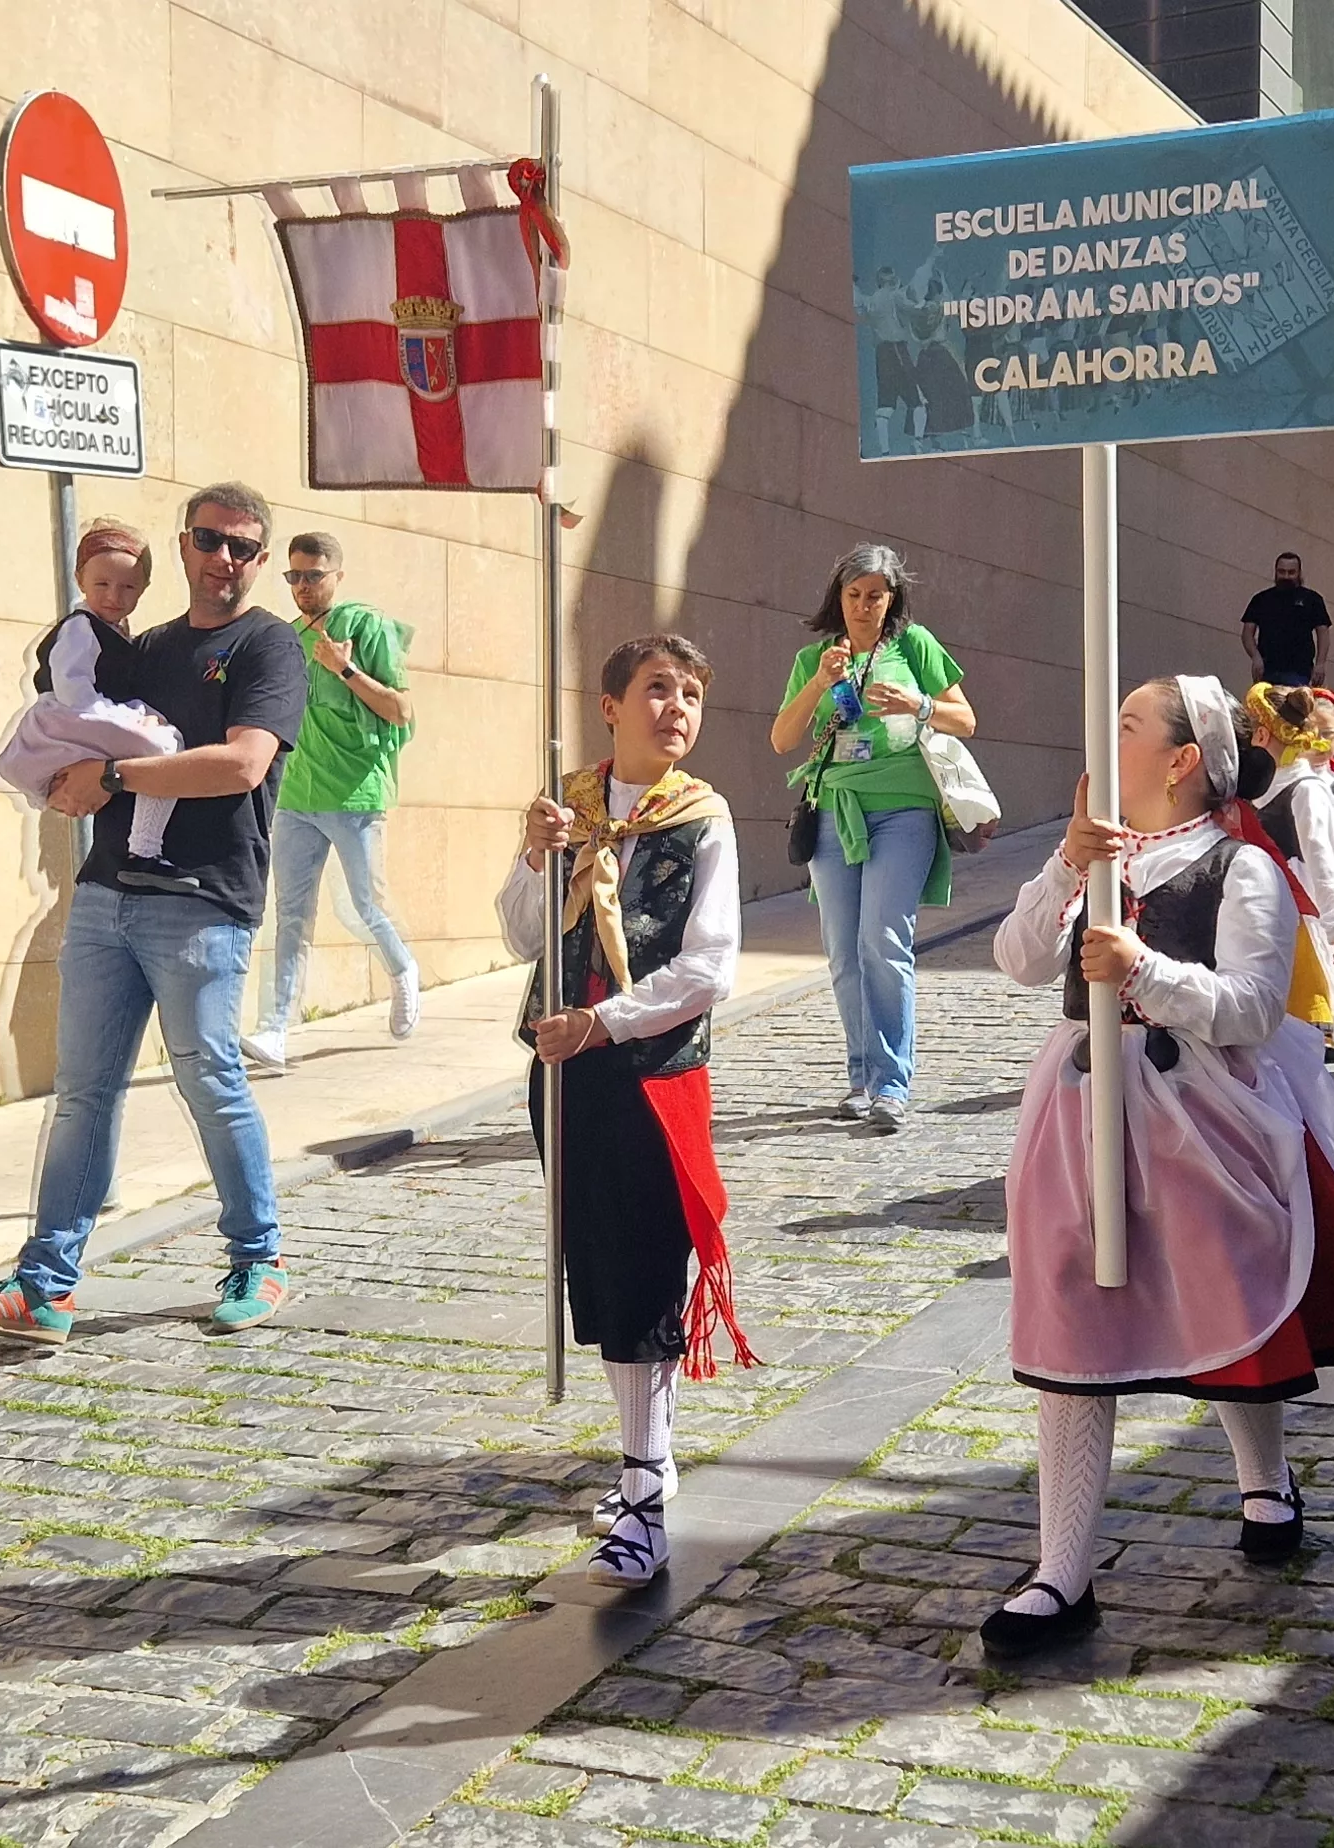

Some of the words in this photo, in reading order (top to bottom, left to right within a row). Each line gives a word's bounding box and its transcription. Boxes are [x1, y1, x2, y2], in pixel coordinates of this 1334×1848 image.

[935, 199, 1077, 242] ESCUELA
[1082, 178, 1267, 227] MUNICIPAL
[1264, 185, 1297, 239] SANTA
[1008, 247, 1047, 280] DE
[1052, 232, 1187, 276] DANZAS
[943, 287, 1062, 329] "ISIDRA
[1067, 287, 1103, 319] M.
[1108, 271, 1260, 315] SANTOS"
[1247, 305, 1320, 356] HUESCA
[28, 365, 109, 395] EXCEPTO
[974, 339, 1218, 393] CALAHORRA
[7, 424, 99, 453] RECOGIDA
[102, 435, 136, 457] R.U.
